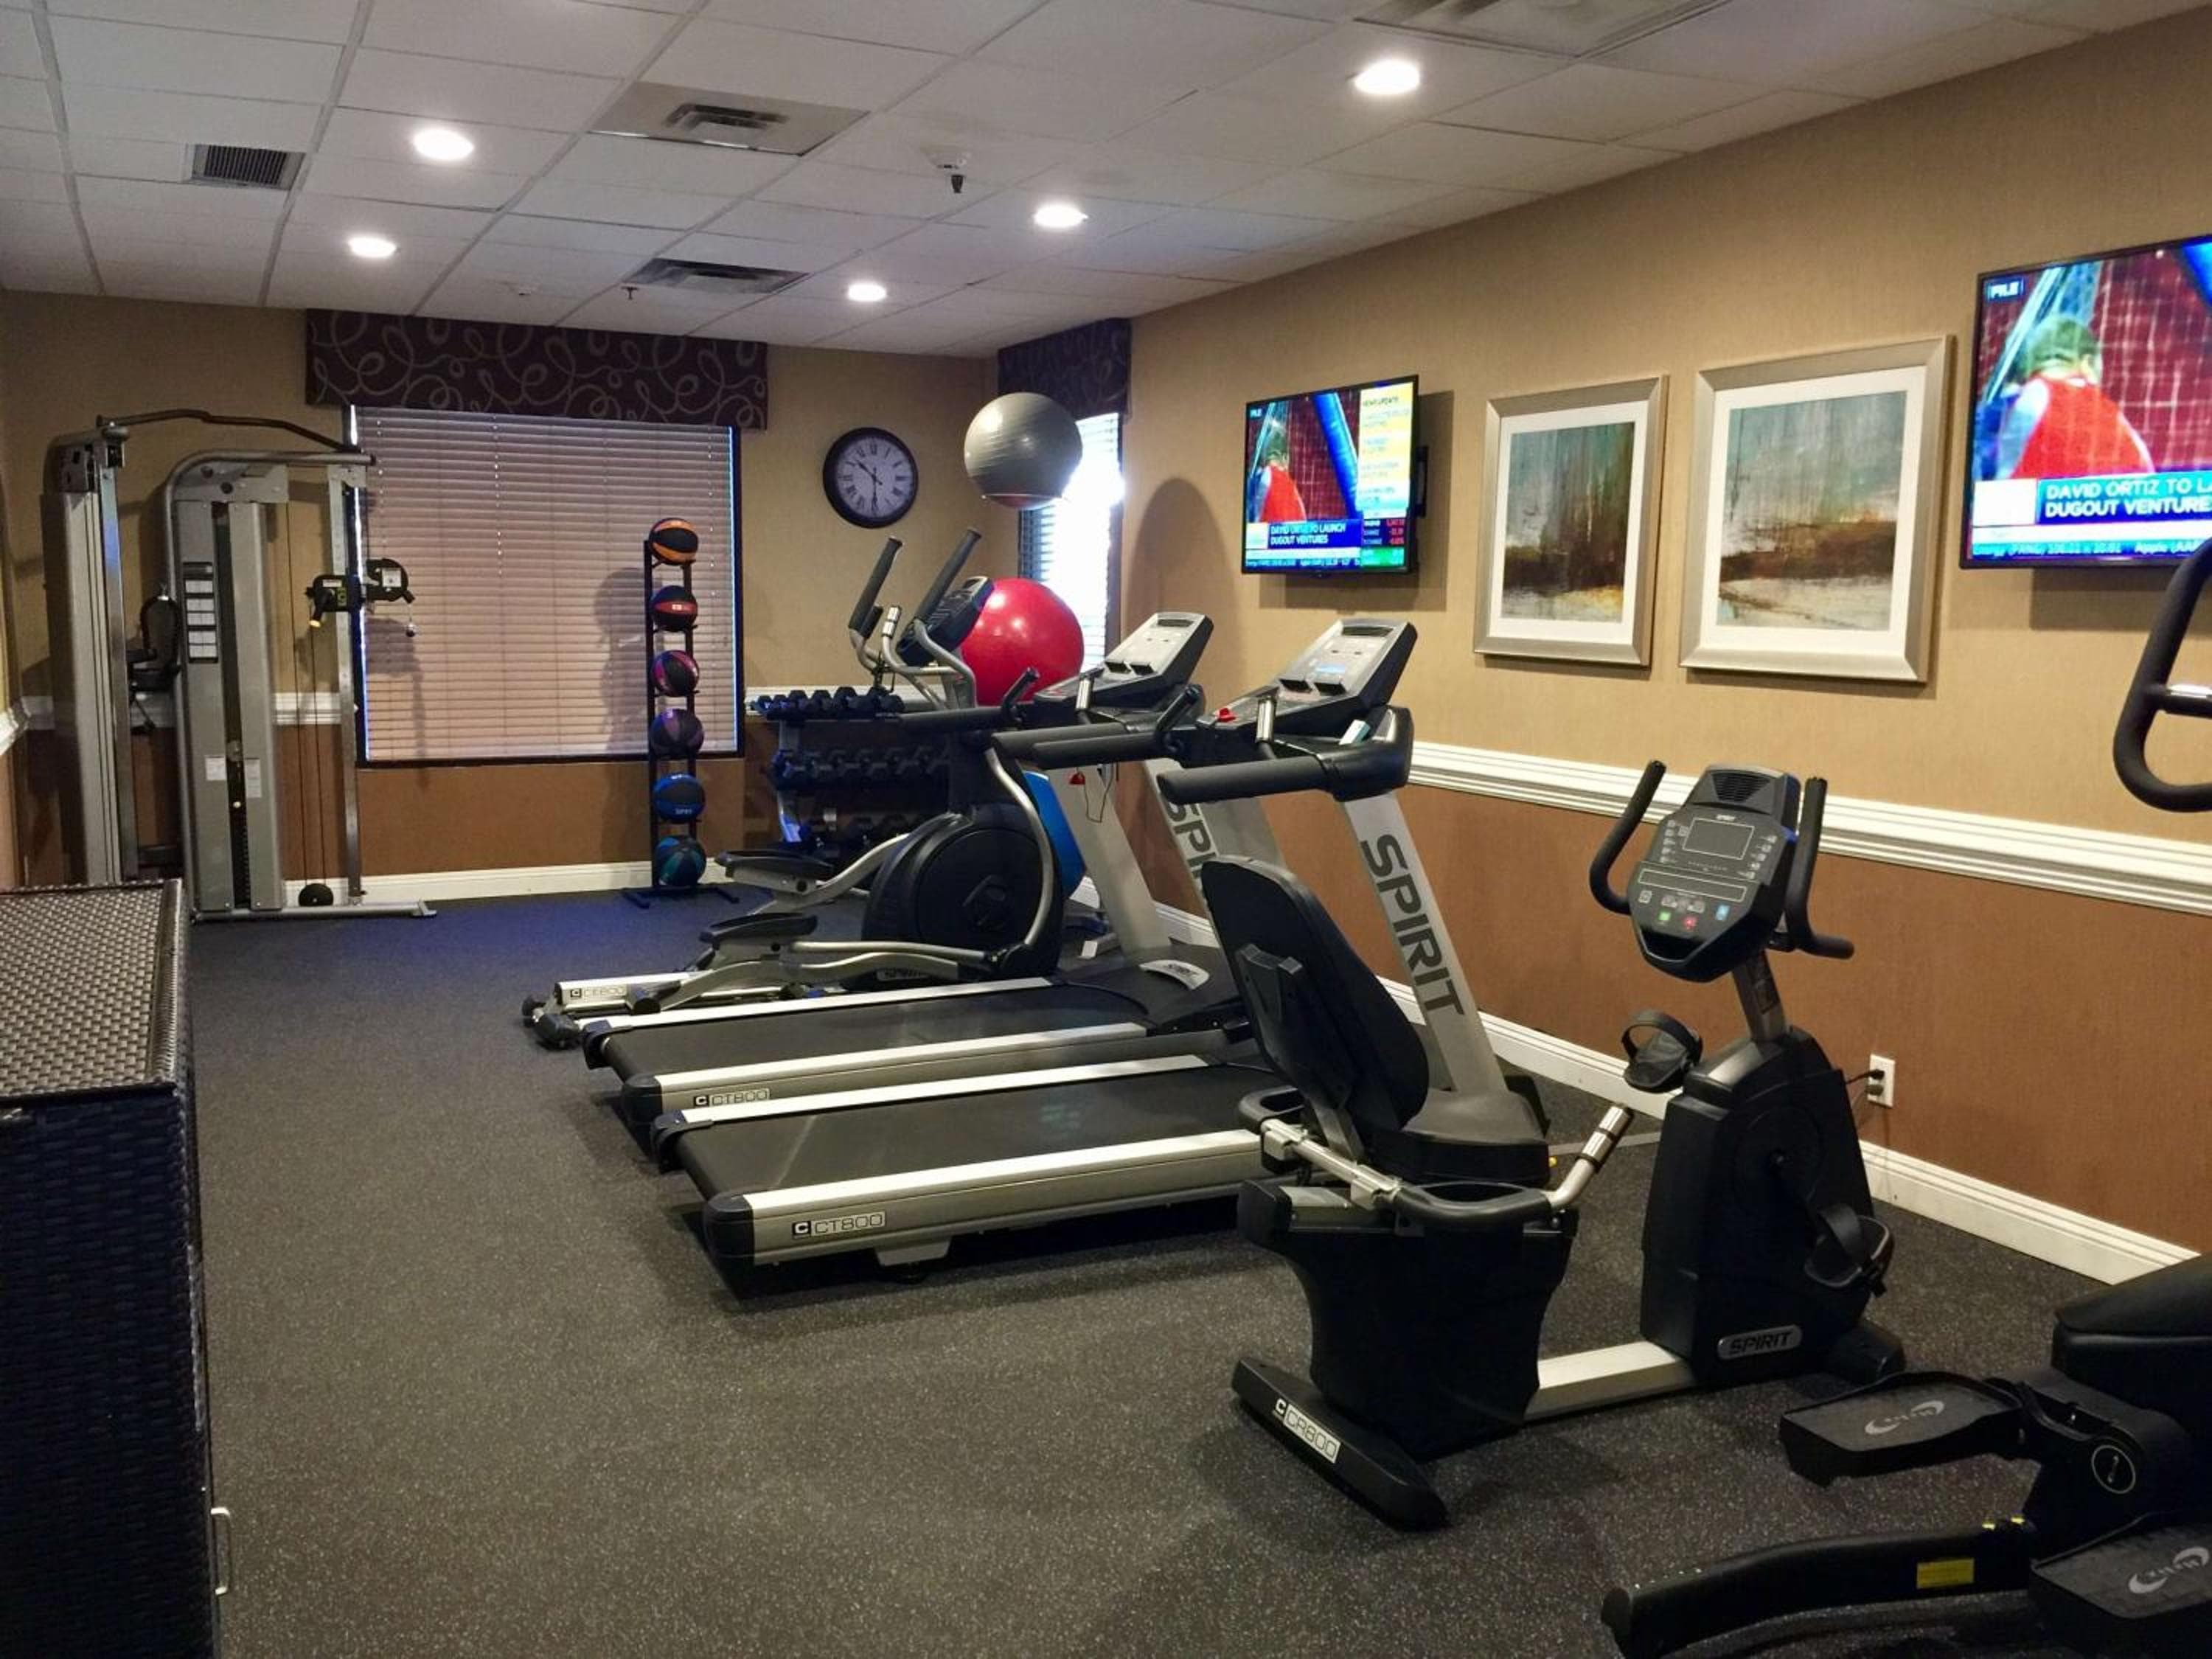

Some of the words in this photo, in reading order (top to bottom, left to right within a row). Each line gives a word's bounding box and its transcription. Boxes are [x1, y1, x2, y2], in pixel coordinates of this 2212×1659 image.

[2047, 483, 2101, 499] DAVID
[2106, 480, 2160, 496] ORTIZ
[2166, 478, 2192, 494] TO
[2045, 500, 2120, 518] DUGOUT
[1360, 834, 1464, 1015] SPIRIT
[815, 1214, 883, 1234] CT800
[1730, 1332, 1792, 1354] SPIRIT
[1287, 1410, 1338, 1458] CR800
